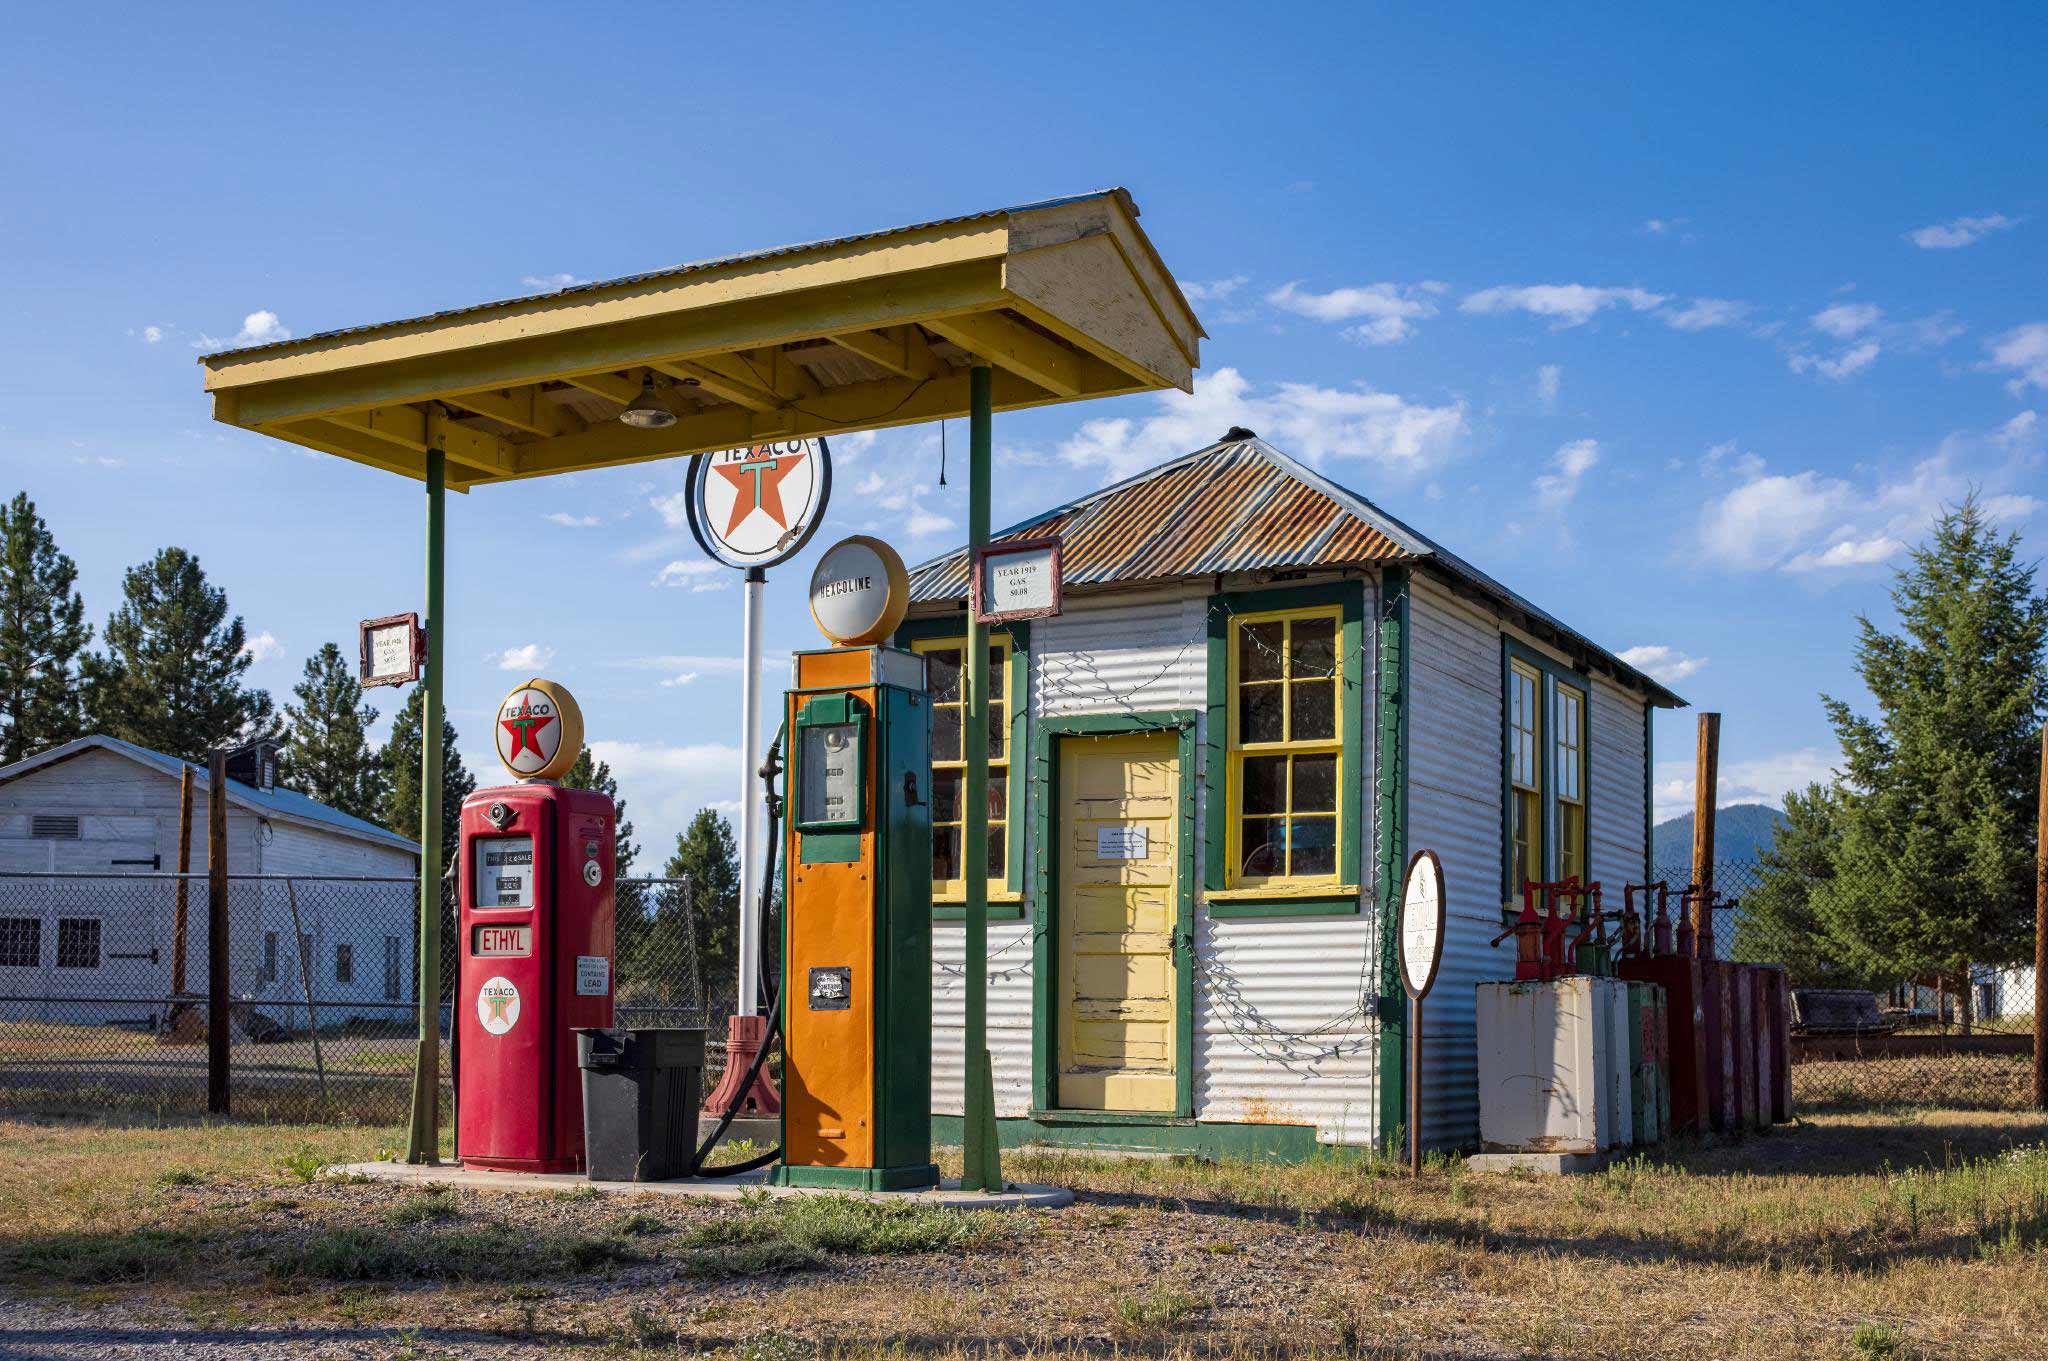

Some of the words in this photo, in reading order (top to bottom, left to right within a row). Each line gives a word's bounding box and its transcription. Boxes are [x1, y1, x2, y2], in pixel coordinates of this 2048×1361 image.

[725, 440, 802, 461] TEXACO
[998, 567, 1019, 577] YEAR
[1010, 578, 1026, 586] GAS
[506, 704, 550, 718] TEXACO
[483, 929, 524, 951] ETHYL
[584, 979, 602, 988] LEAD
[483, 987, 515, 996] TEXACO
